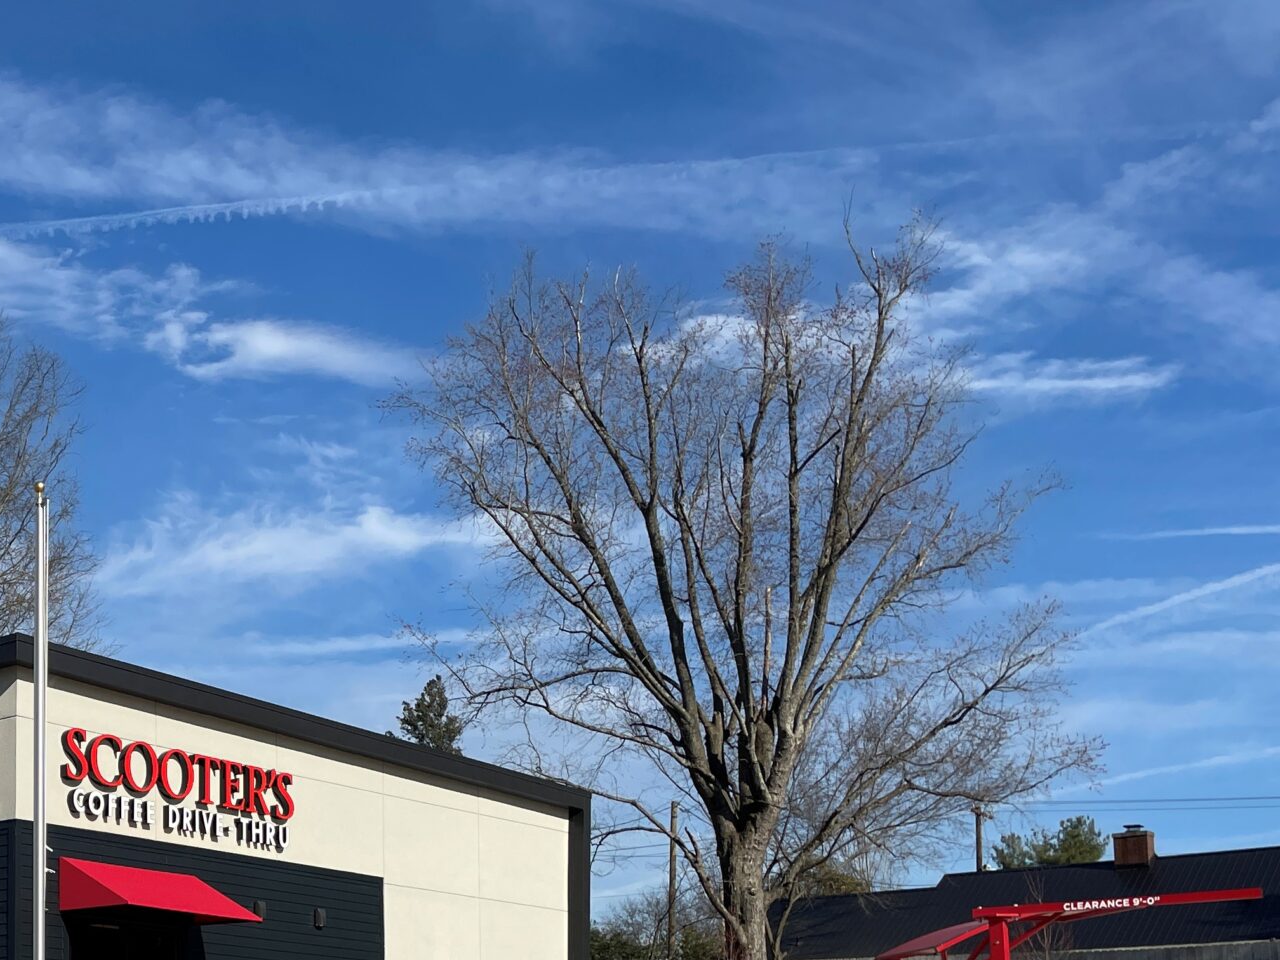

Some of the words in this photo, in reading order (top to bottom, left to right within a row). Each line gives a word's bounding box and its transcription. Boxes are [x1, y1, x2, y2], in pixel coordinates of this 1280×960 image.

[62, 727, 295, 821] SCOOTER'S
[72, 788, 156, 825] COFFEE
[1063, 898, 1130, 911] CLEARANCE
